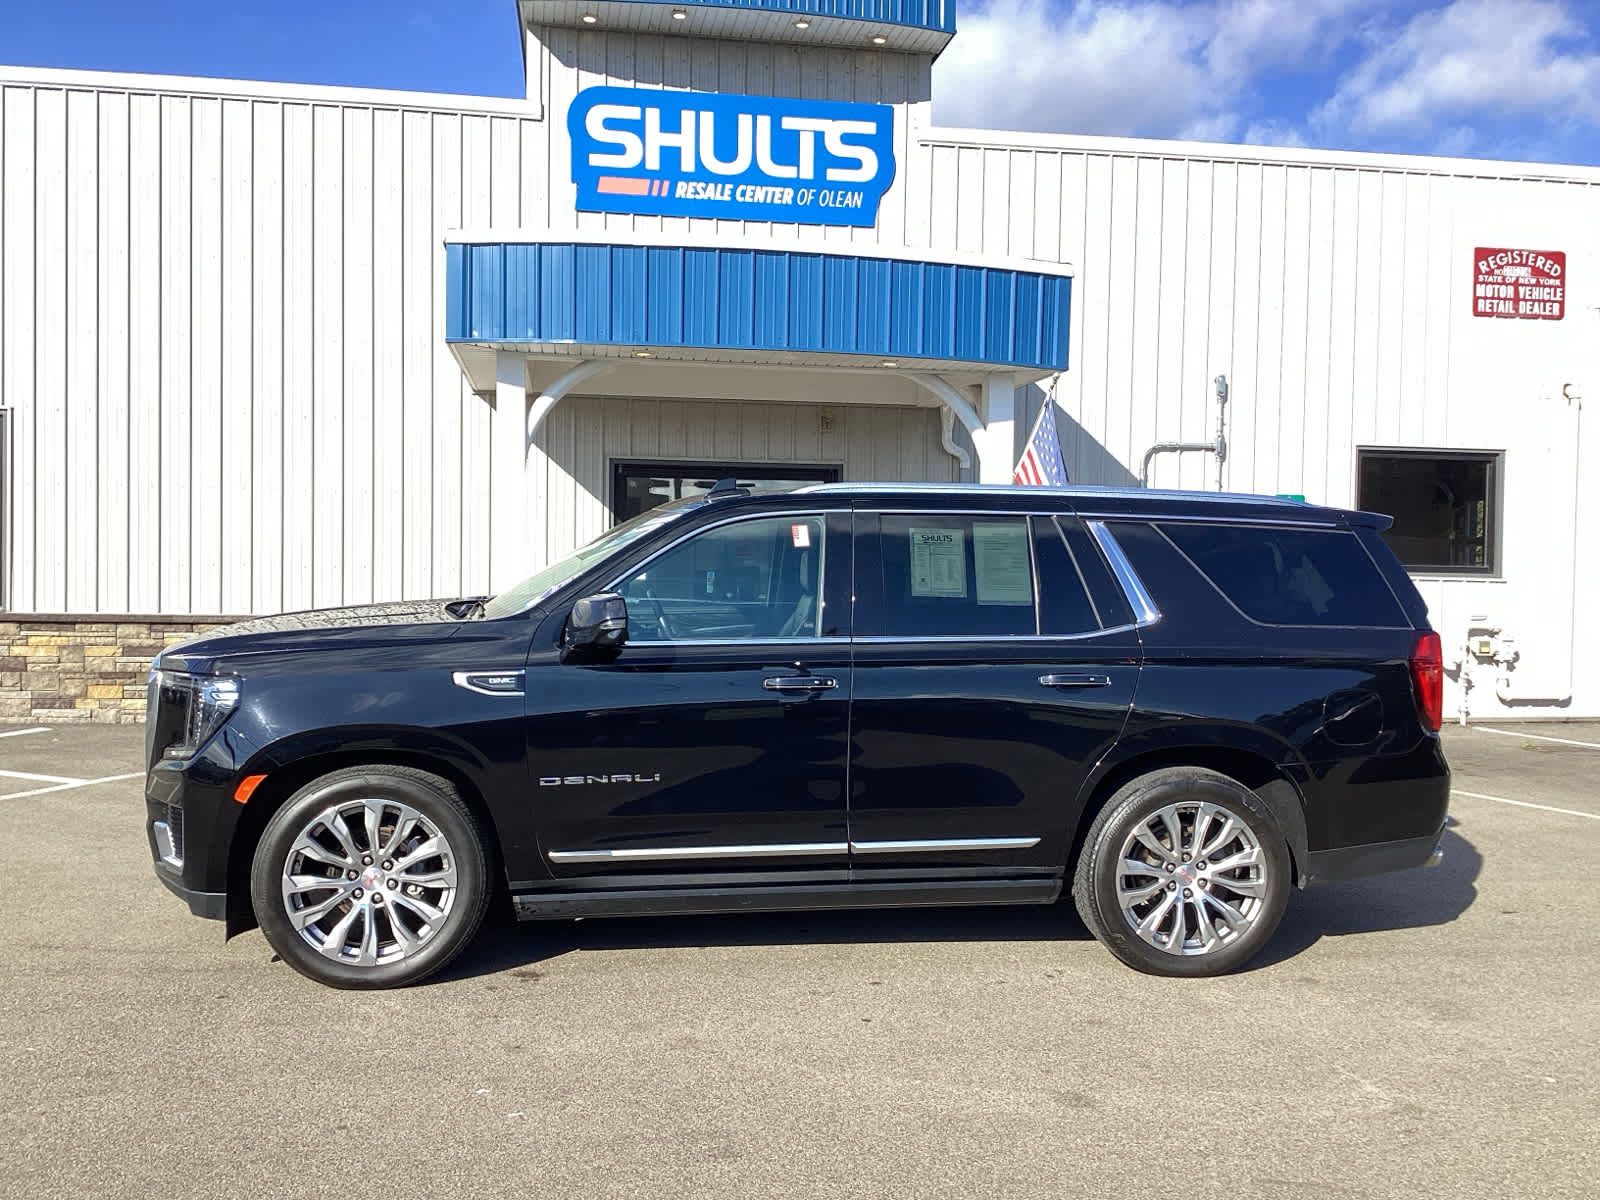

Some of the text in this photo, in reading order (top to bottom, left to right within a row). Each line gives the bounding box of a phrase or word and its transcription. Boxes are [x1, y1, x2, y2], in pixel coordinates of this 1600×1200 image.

[585, 103, 879, 183] SHULTS
[675, 180, 864, 209] RESALE CENTER OF OLEAN
[1477, 250, 1562, 277] REGISTERED
[1477, 274, 1561, 286] STATE OF NEW YORK
[1475, 283, 1563, 301] MOTOR VEHICLE
[1477, 298, 1560, 316] RETAIL DEALER
[921, 534, 953, 542] SHULTS
[539, 773, 660, 786] DENALI
